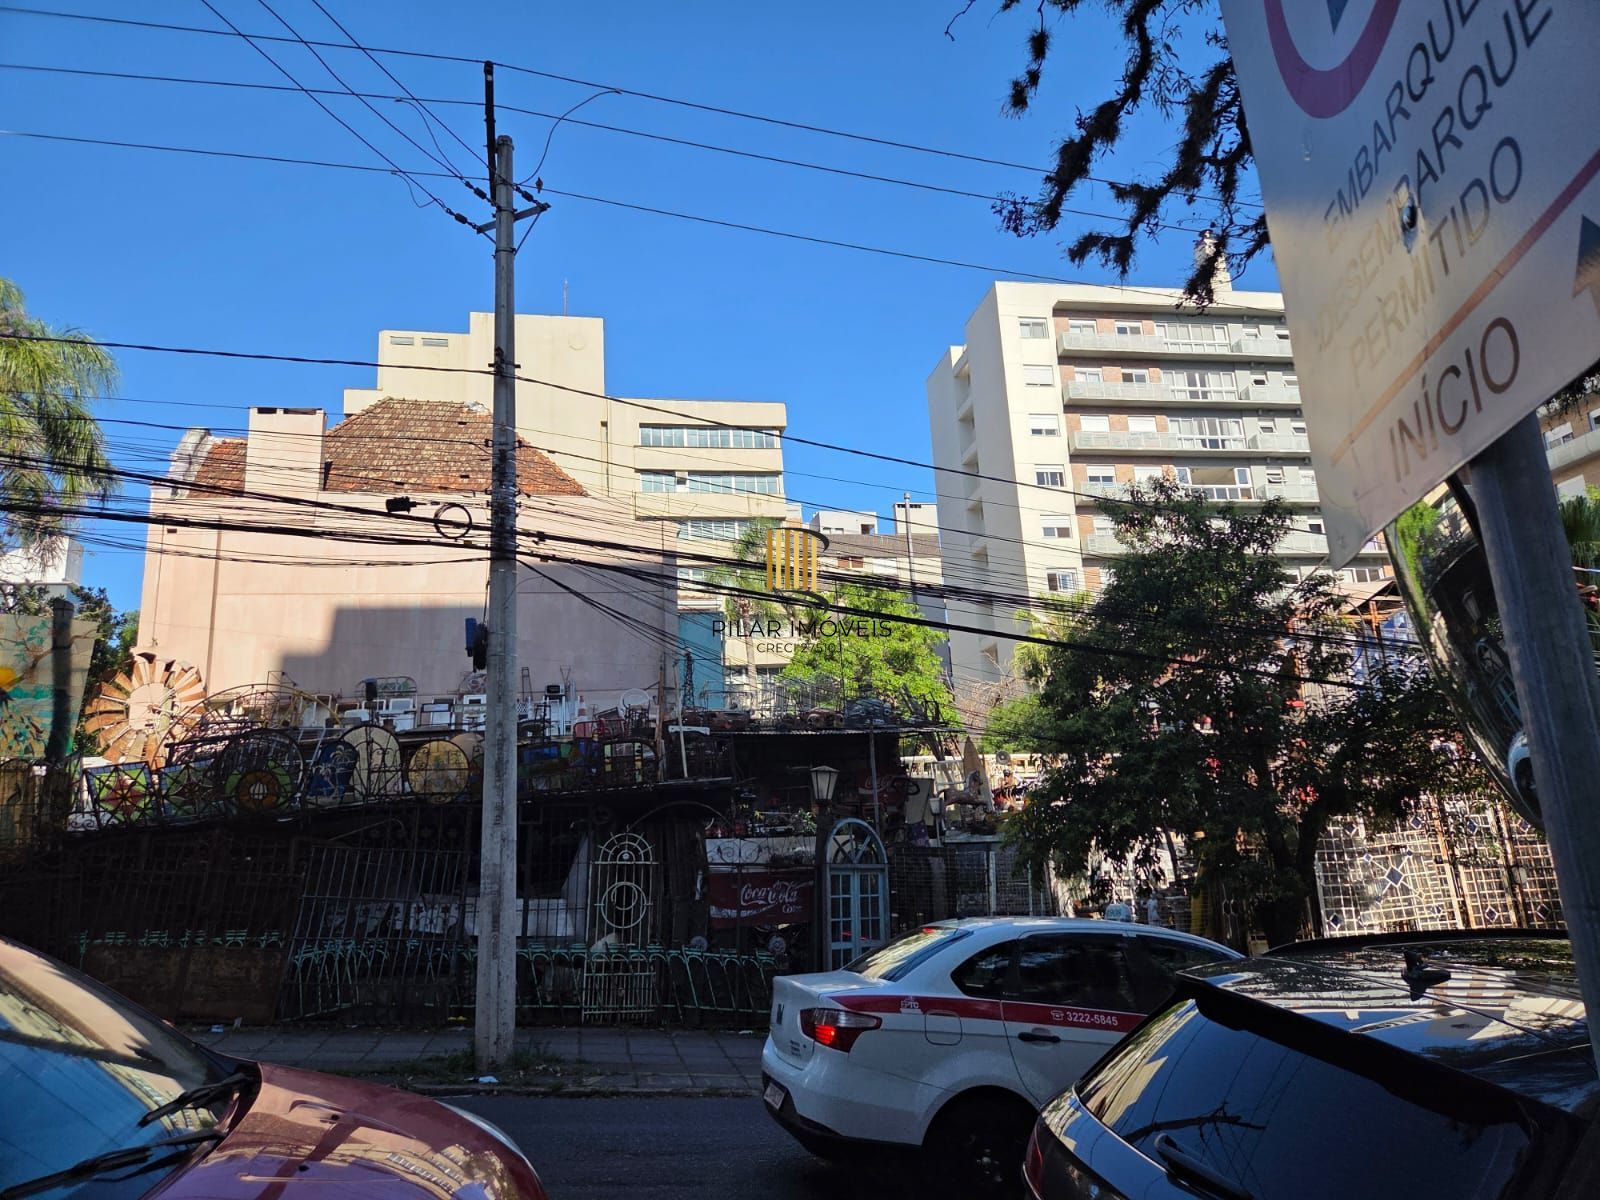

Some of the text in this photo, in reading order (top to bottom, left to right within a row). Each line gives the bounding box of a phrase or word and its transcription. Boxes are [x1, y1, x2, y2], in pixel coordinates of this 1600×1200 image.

[1350, 136, 1523, 389] PERMITIDO
[1389, 316, 1520, 484] INÍCIO
[1065, 1011, 1119, 1026] 3222-5845
